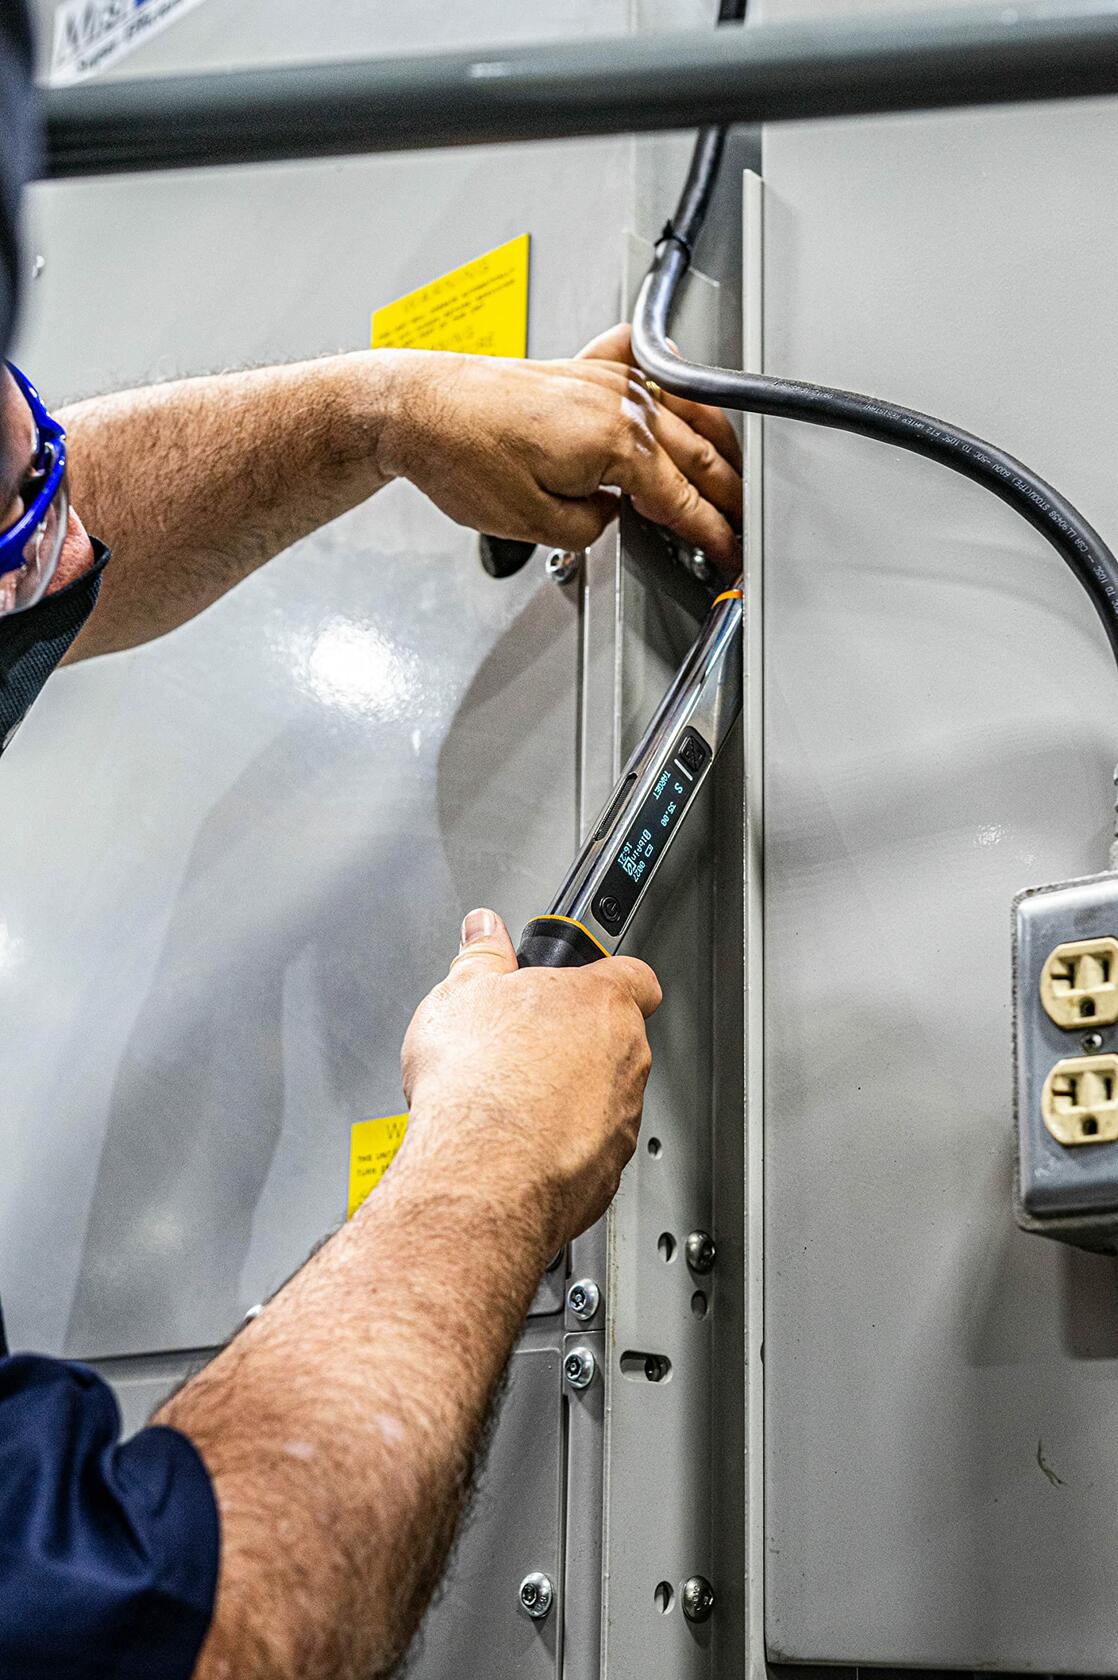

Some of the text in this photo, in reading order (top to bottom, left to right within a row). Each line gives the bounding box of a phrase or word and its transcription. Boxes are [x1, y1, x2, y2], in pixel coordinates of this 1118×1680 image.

[652, 770, 671, 800] TARGET
[660, 801, 677, 827] 35.00
[617, 842, 633, 867] 16:21
[632, 860, 646, 883] 0027
